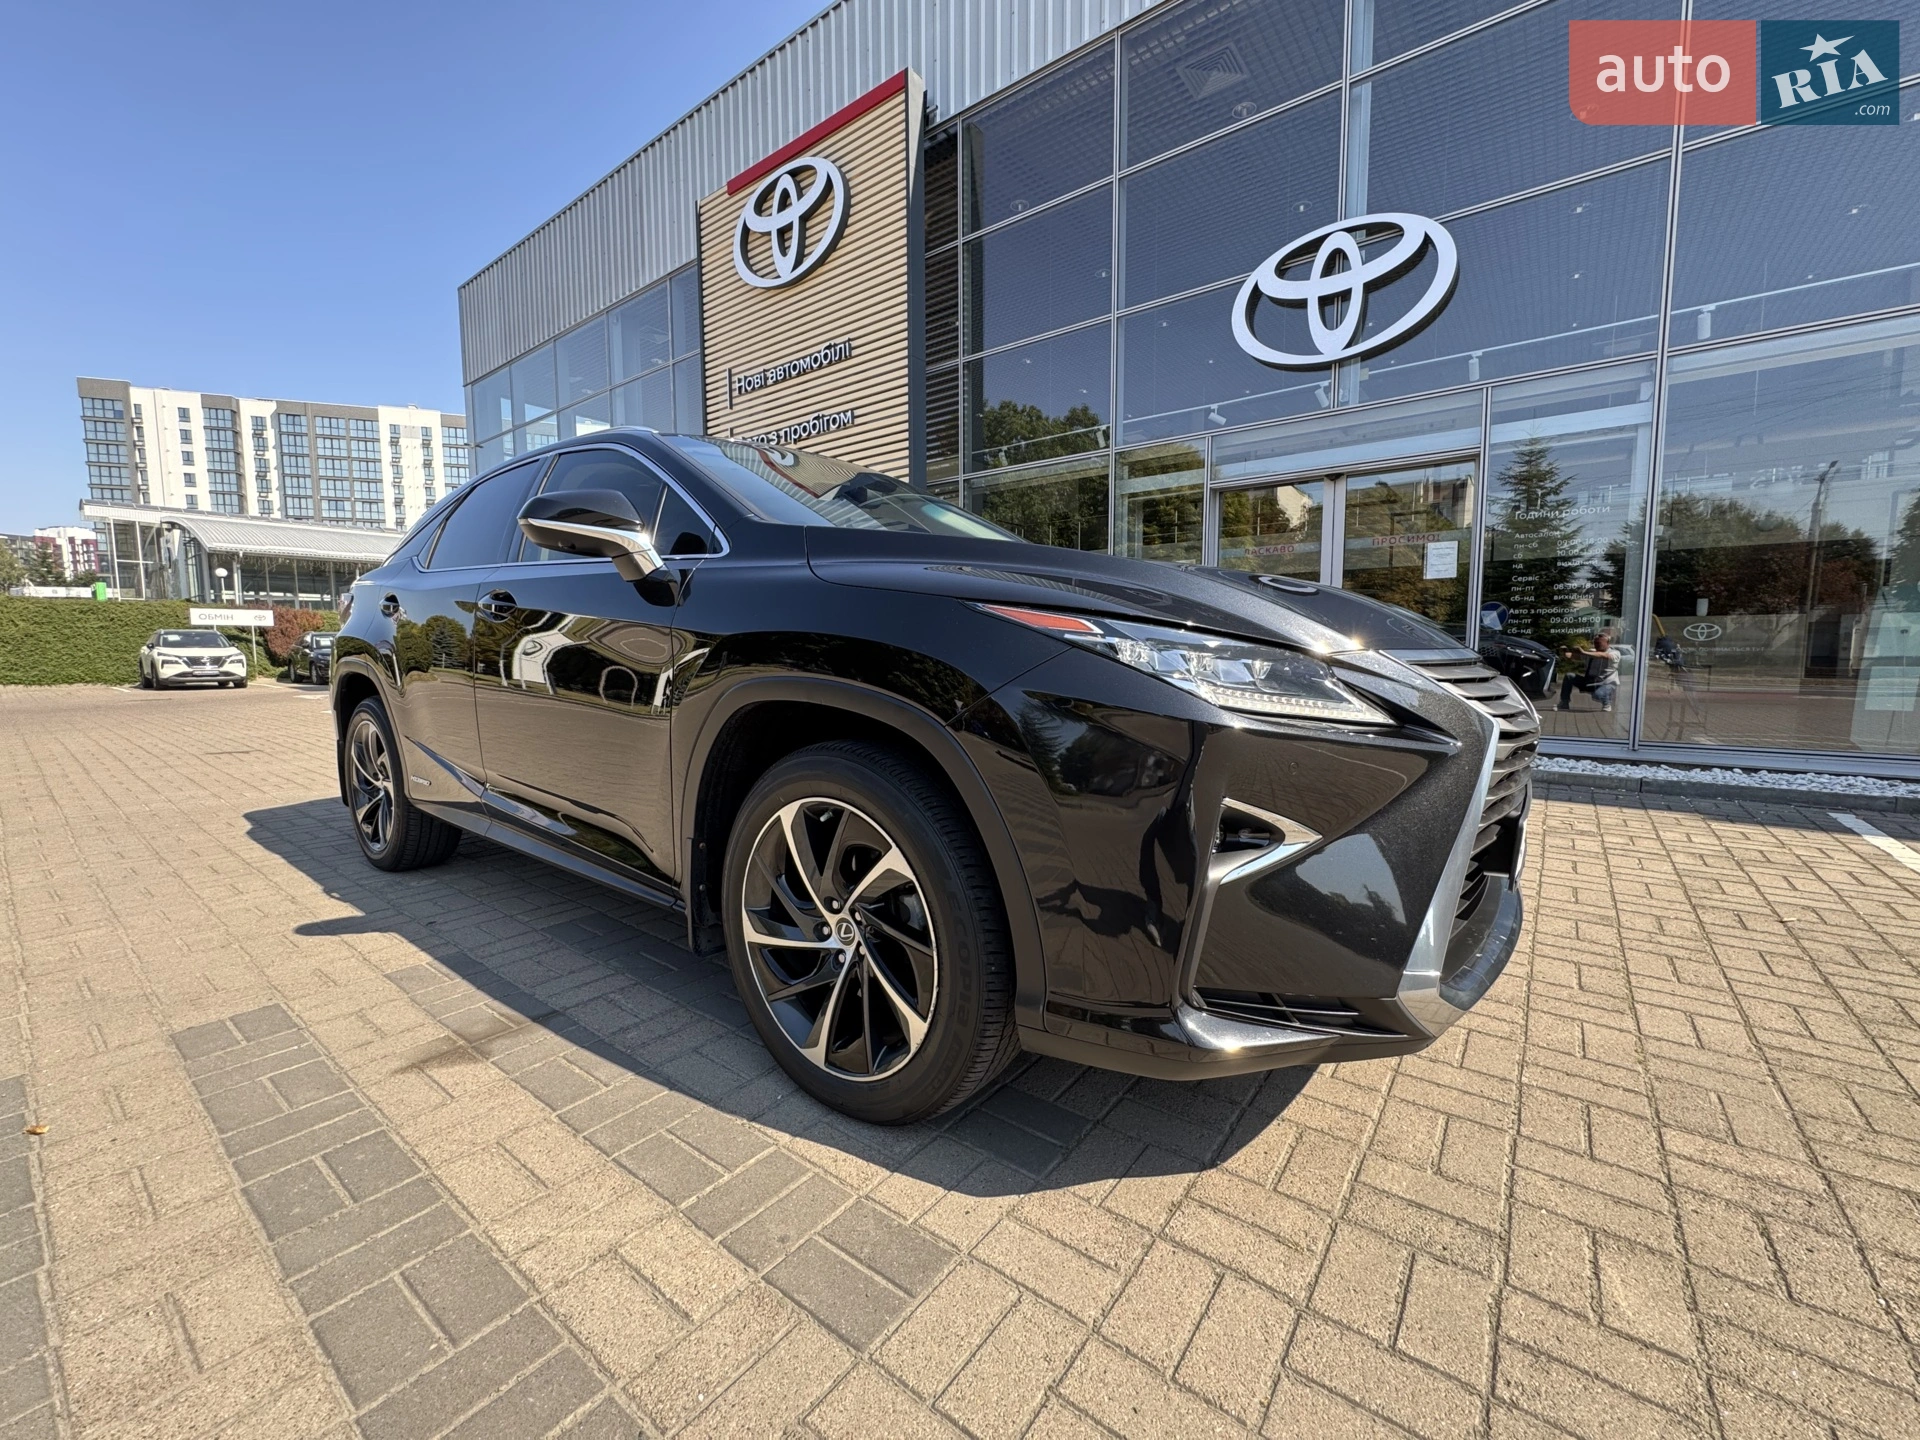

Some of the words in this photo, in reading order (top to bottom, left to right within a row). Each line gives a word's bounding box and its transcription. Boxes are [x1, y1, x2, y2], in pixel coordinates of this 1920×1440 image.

[736, 371, 765, 394] Нові
[768, 340, 851, 383] автомобілі
[781, 410, 853, 444] пробігом
[1514, 510, 1560, 520] Години
[1562, 506, 1610, 518] роботи
[1372, 533, 1441, 547] ПРОСИМО!
[1511, 574, 1540, 583] Сервіс
[1510, 594, 1536, 602] сб-нд
[1536, 607, 1577, 616] пробігом
[198, 613, 234, 621] ОБМІН
[1507, 627, 1532, 635] сб-нд
[1550, 626, 1592, 634] вихідний
